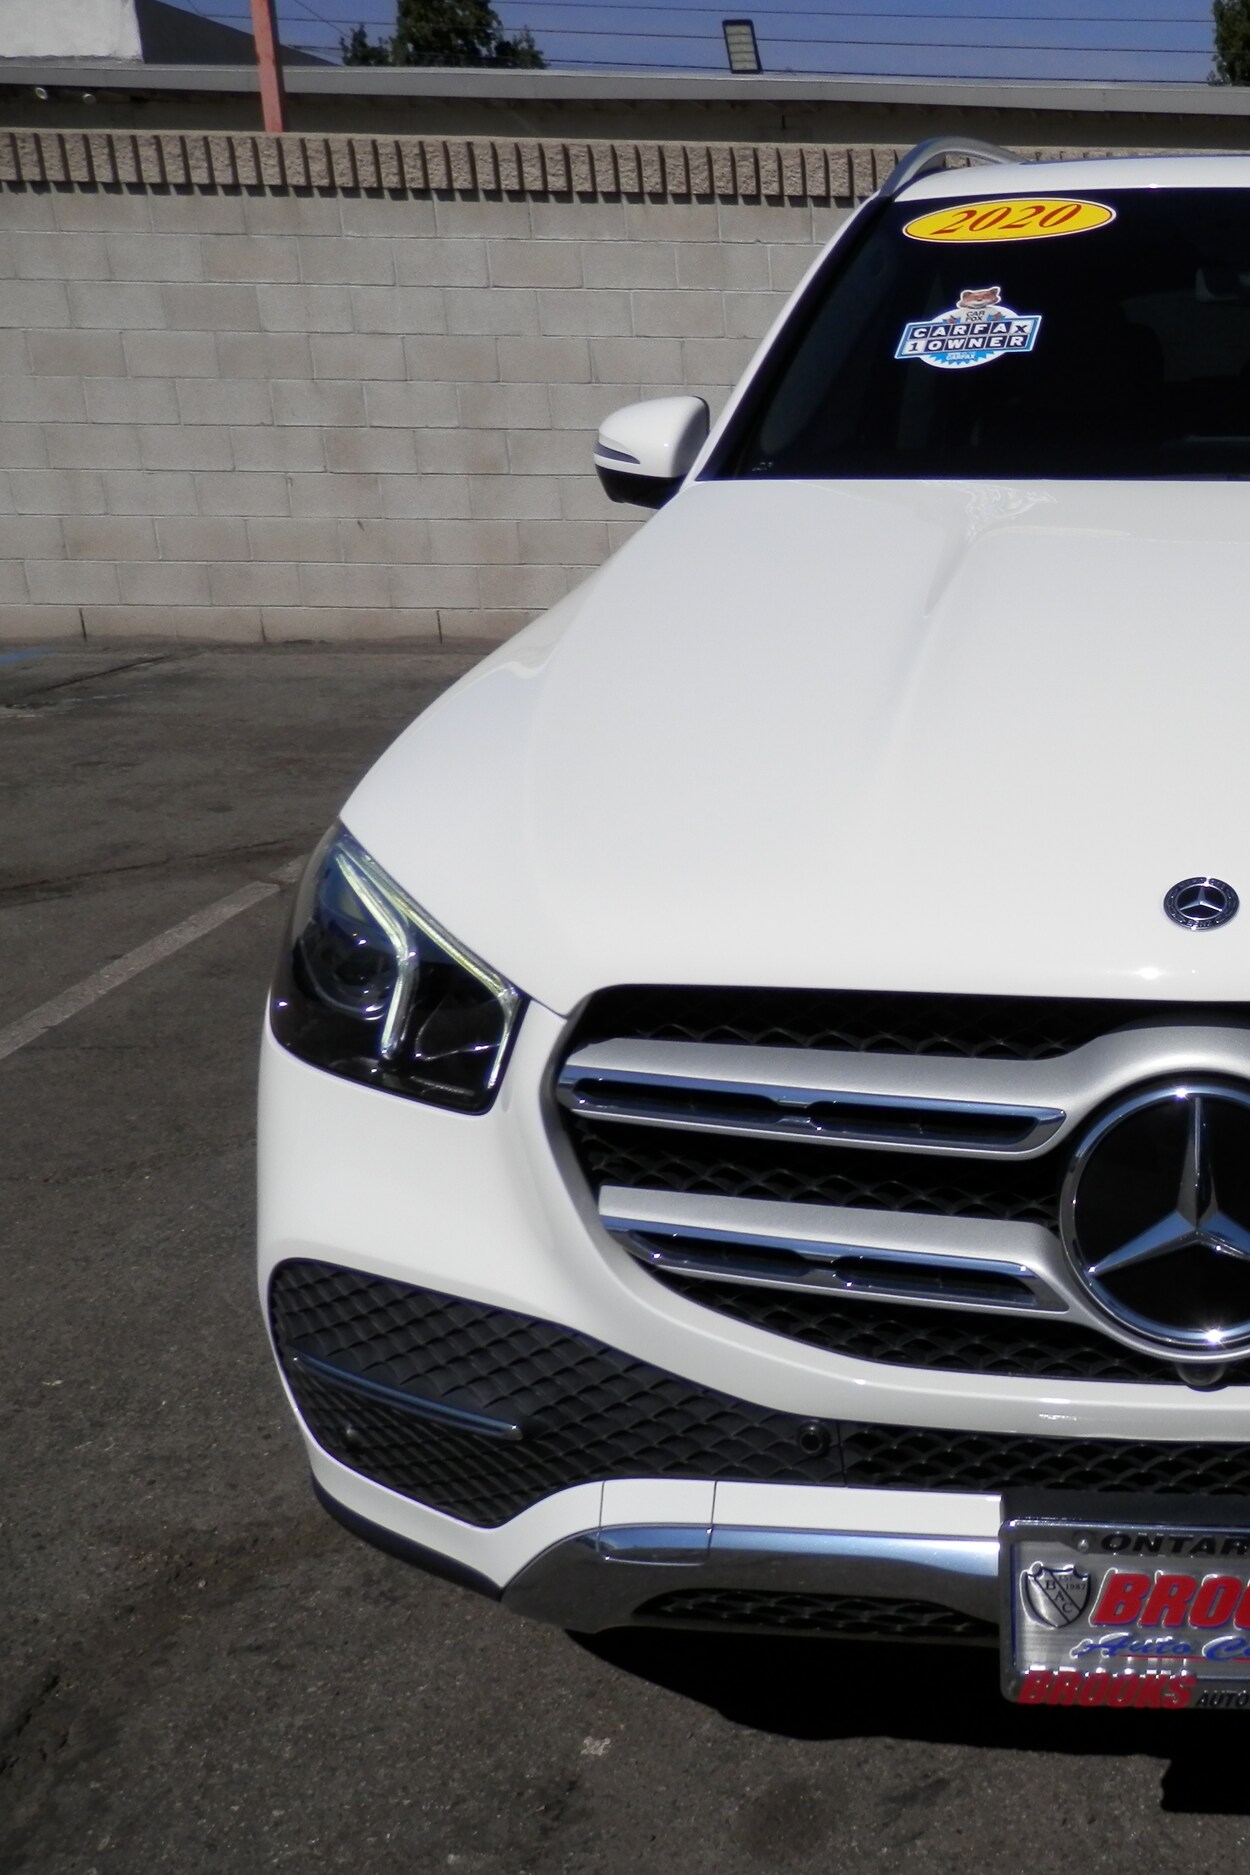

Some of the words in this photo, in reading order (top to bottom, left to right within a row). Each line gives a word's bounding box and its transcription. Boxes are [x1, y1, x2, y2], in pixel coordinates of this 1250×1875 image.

[929, 203, 1082, 236] 2020
[912, 321, 1029, 338] CARFAX
[908, 341, 920, 352] 1
[927, 336, 1024, 352] OWNER
[1071, 1633, 1192, 1659] Auto
[1016, 1668, 1198, 1709] BROOKS
